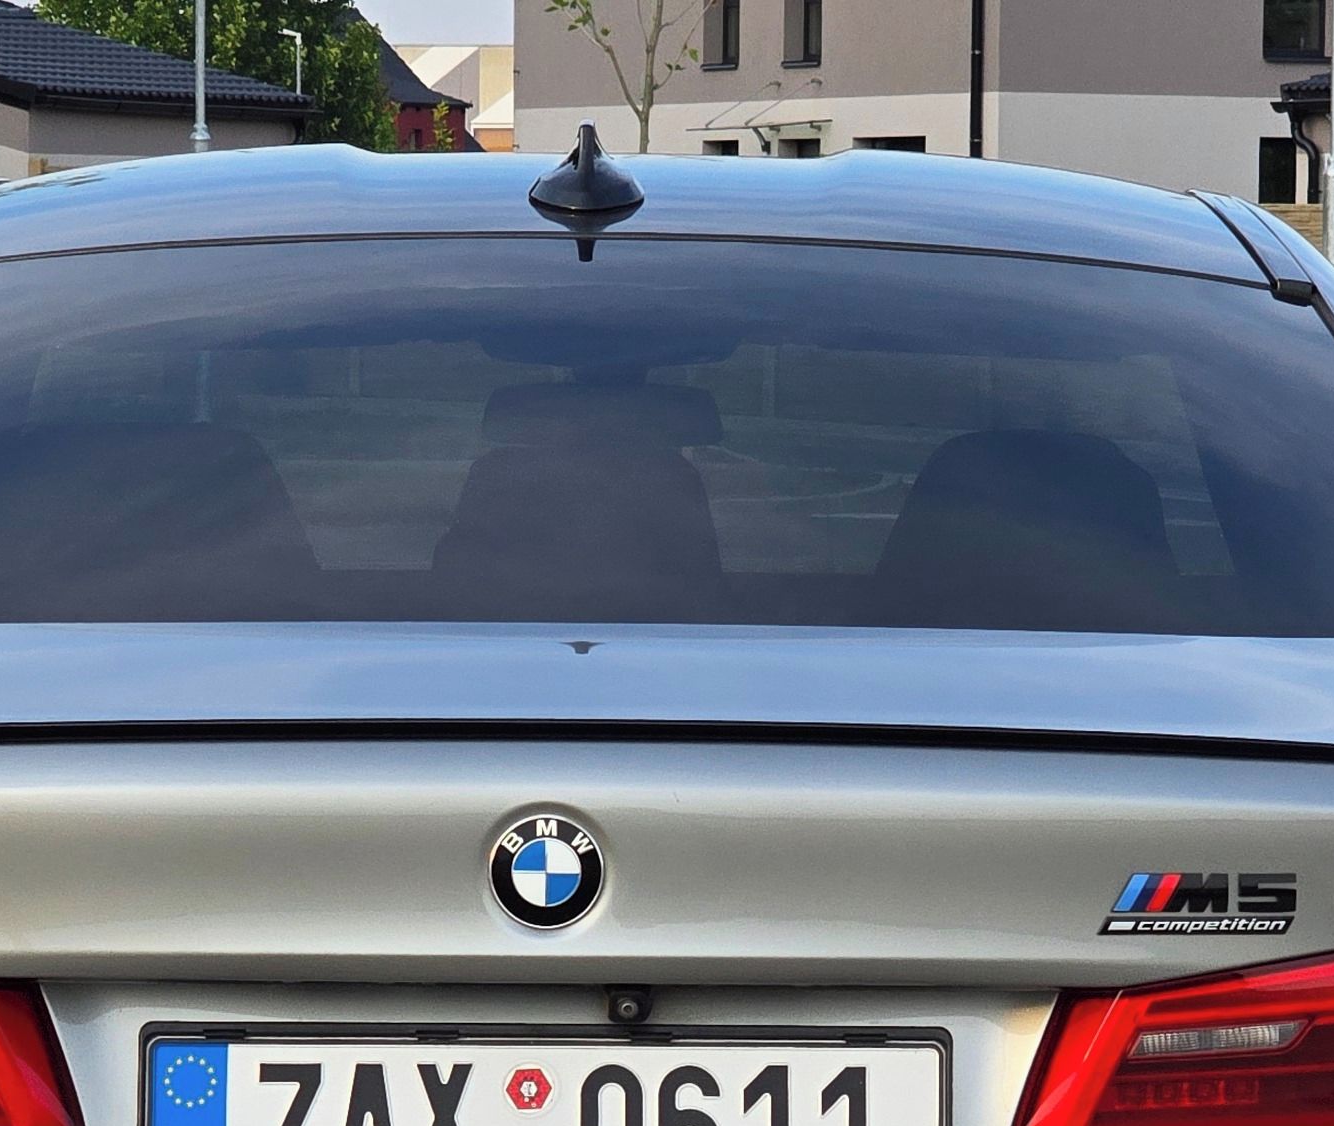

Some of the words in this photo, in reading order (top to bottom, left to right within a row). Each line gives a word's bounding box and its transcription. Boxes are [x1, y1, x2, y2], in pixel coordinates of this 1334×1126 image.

[501, 819, 594, 855] BMW
[1161, 873, 1297, 913] M5
[1137, 918, 1287, 933] competition
